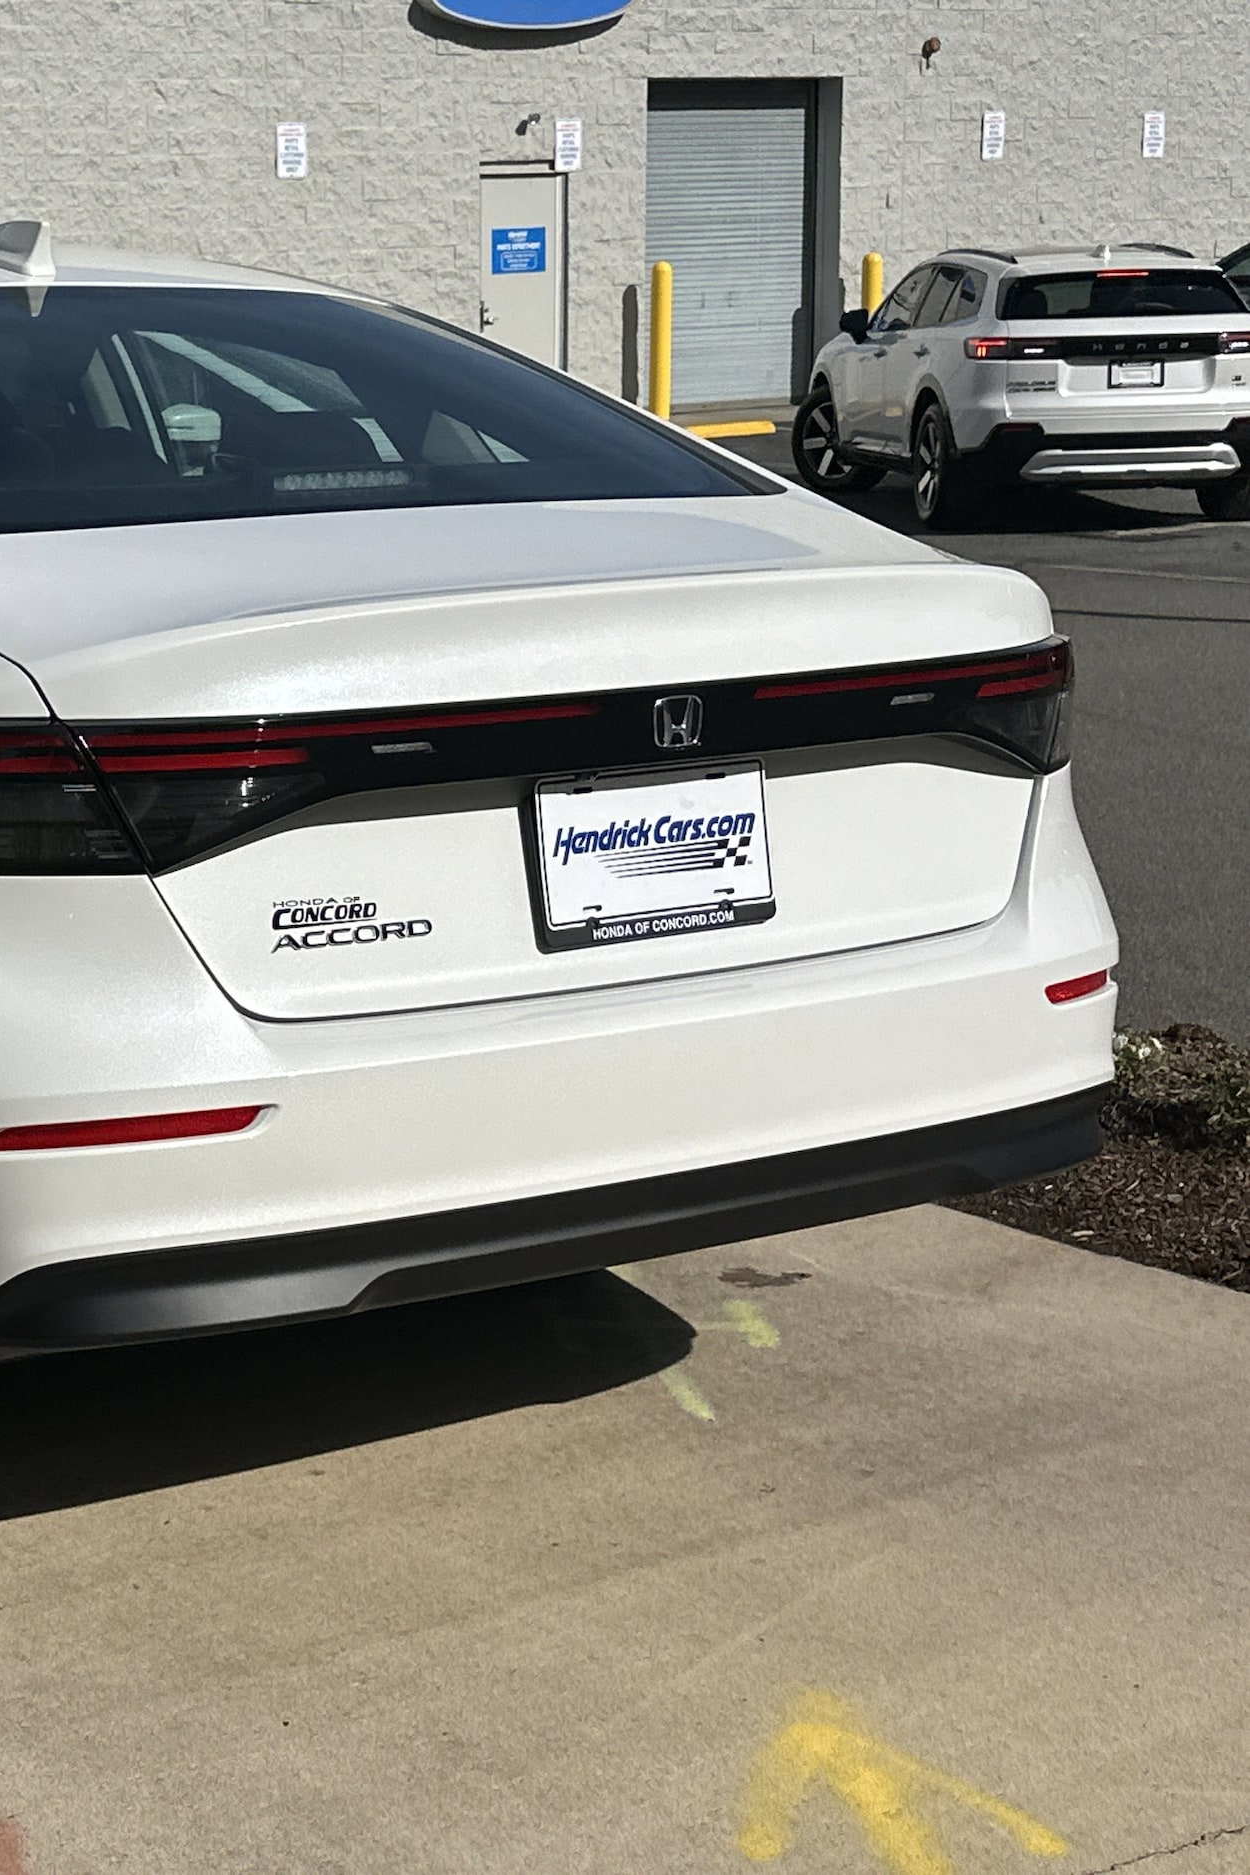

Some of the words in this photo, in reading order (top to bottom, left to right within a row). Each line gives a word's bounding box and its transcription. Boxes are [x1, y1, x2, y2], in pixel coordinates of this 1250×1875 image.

[272, 902, 377, 930] CONCORD
[273, 897, 338, 909] HONDA
[342, 896, 361, 904] OF
[270, 919, 433, 954] ACCORD
[592, 923, 633, 940] HONDA
[635, 920, 651, 935] OF
[652, 910, 735, 932] CONCORD.COM
